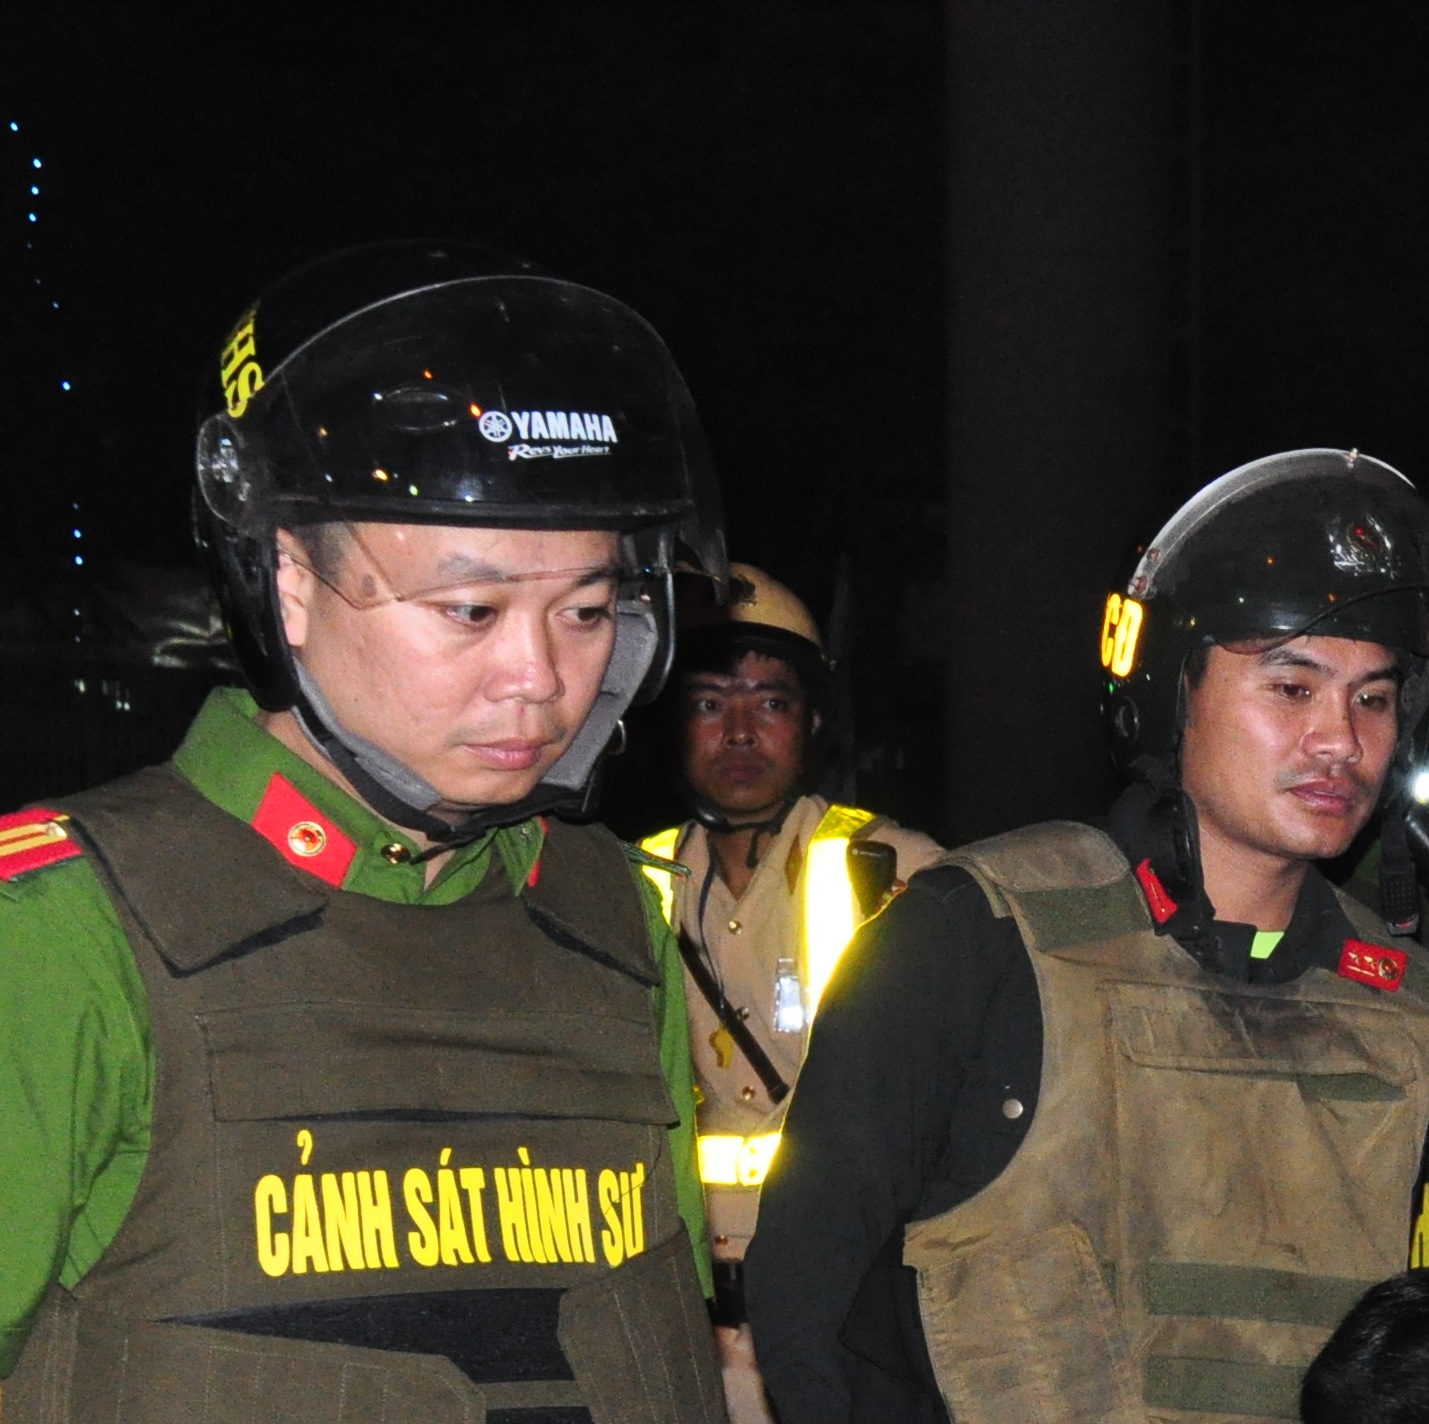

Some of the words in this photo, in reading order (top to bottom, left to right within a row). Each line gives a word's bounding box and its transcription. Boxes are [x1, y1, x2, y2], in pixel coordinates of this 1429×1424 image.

[511, 411, 618, 443] YAMAHA
[255, 1129, 400, 1277] CẢNH
[403, 1148, 492, 1267] SÁT
[493, 1146, 596, 1264] HÌNH
